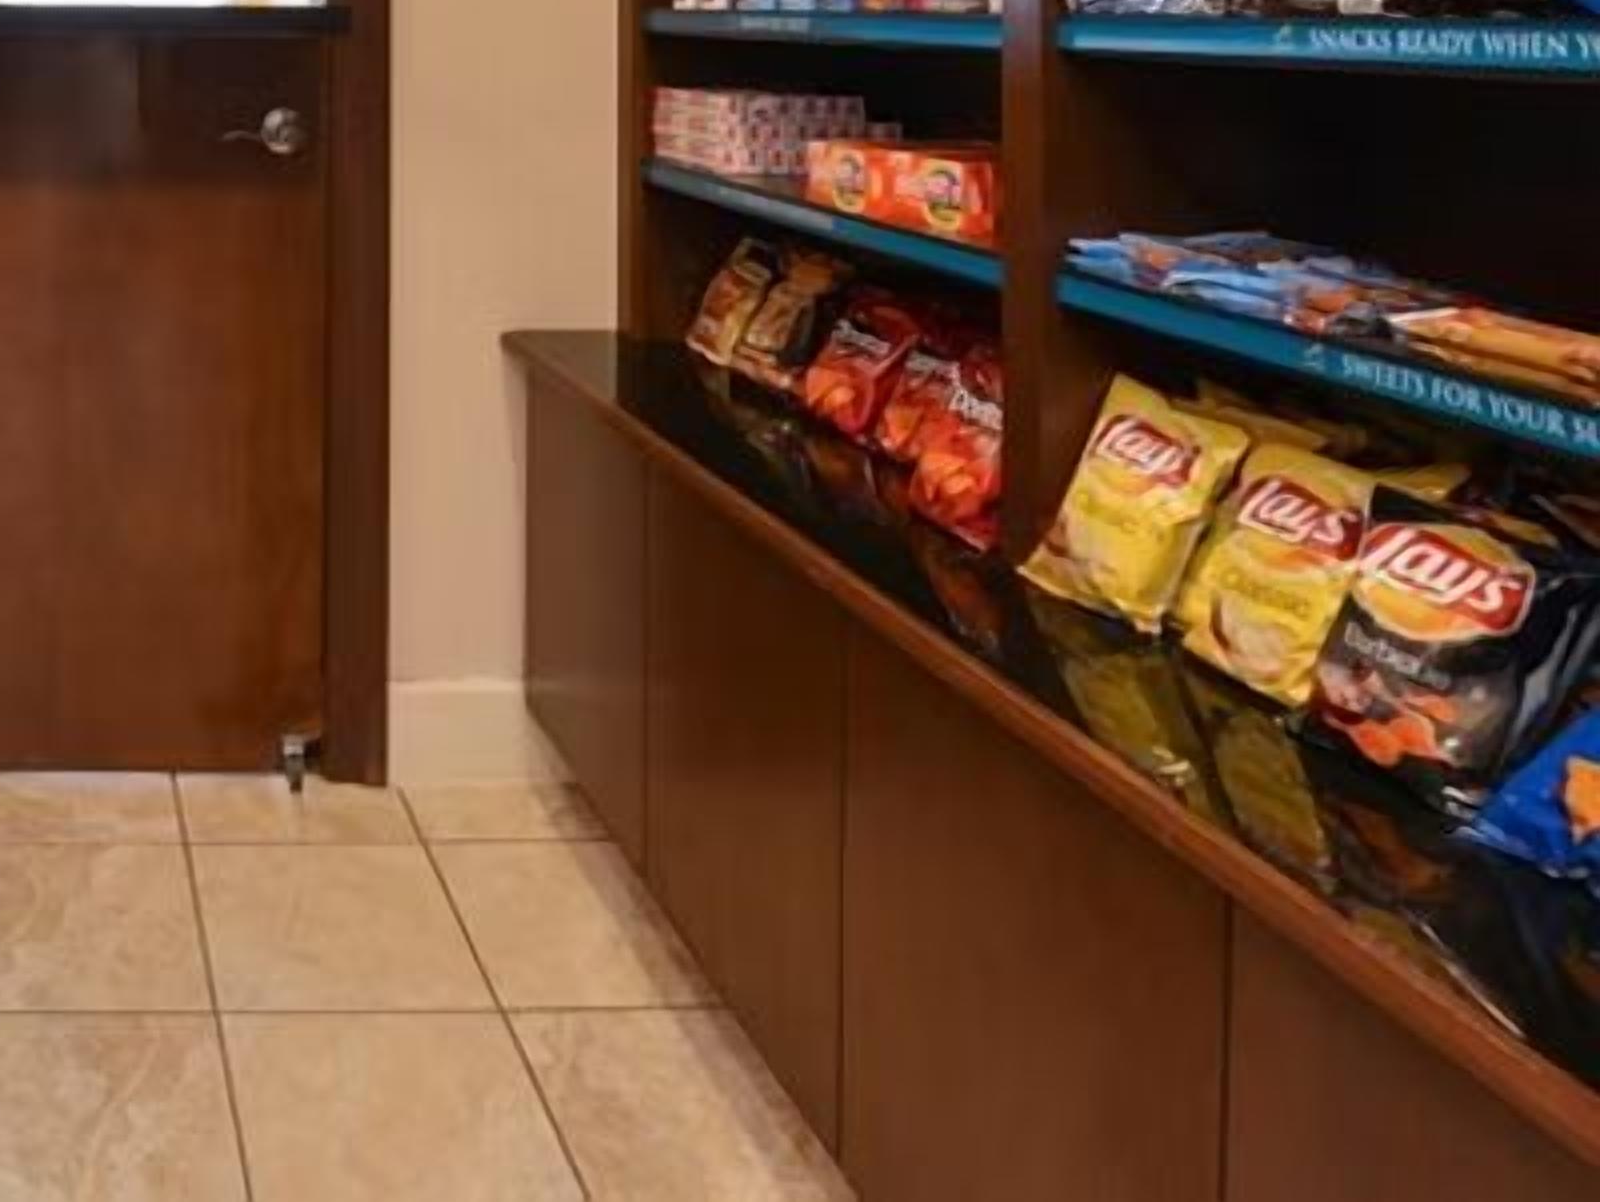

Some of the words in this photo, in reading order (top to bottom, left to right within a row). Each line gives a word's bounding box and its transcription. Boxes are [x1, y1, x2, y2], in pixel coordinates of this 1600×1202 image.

[1309, 28, 1393, 49] SNACKS
[1398, 28, 1476, 56] READY
[1481, 29, 1569, 59] WHEN
[1342, 353, 1425, 398] SWEETS
[1431, 376, 1482, 415] FOR
[1488, 392, 1567, 438] YOUR
